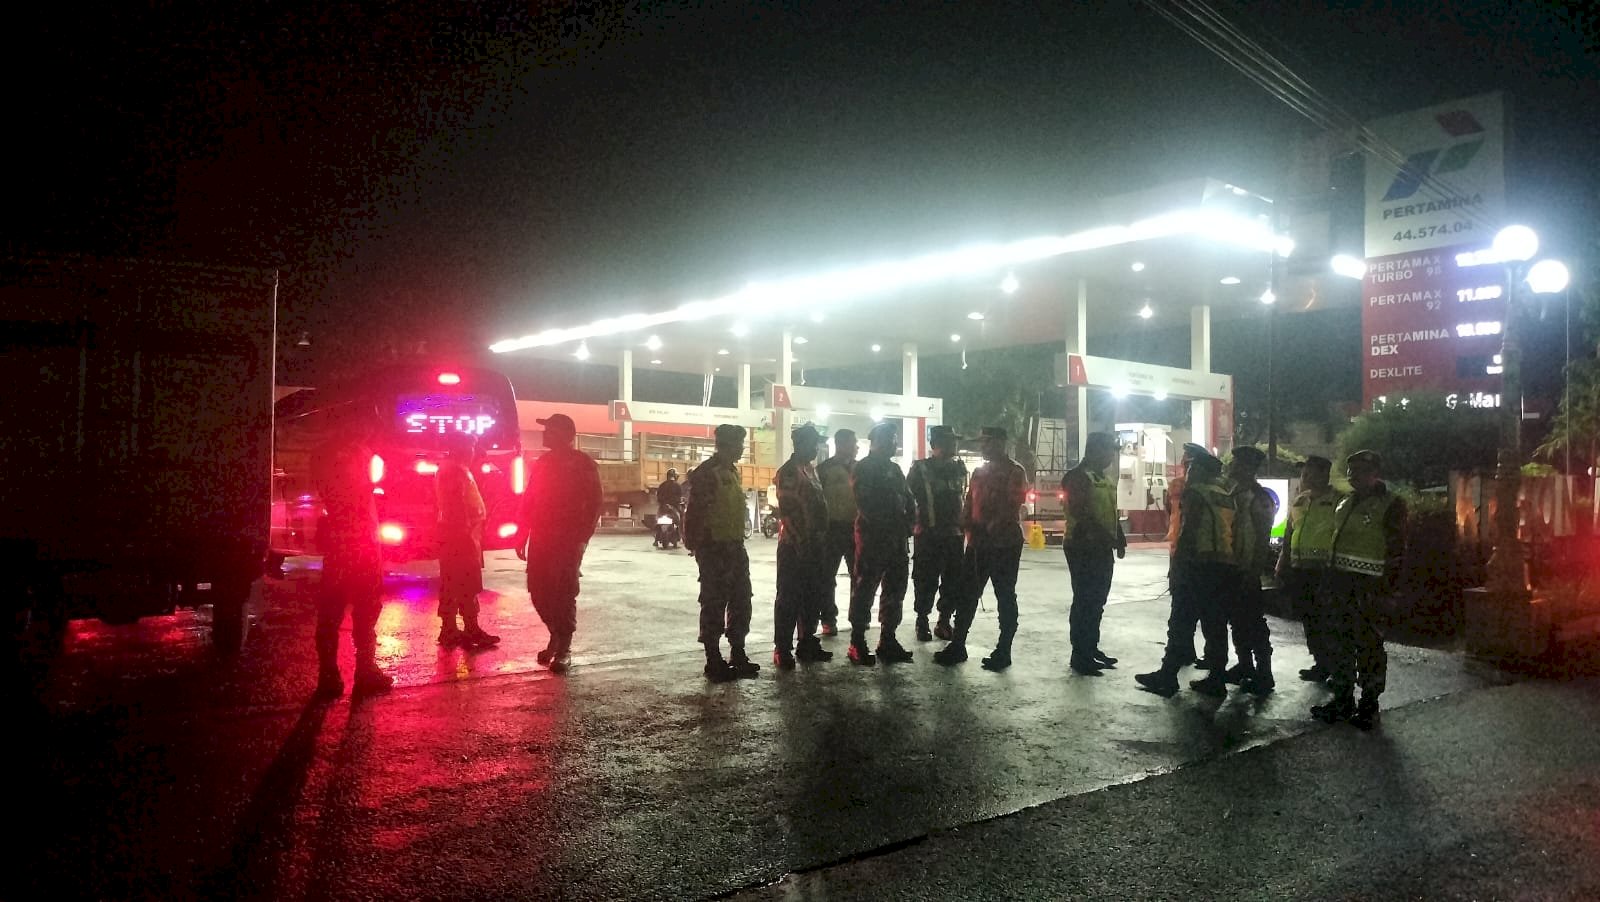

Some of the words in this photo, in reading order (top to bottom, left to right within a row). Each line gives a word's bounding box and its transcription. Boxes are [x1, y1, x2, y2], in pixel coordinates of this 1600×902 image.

[1383, 192, 1483, 220] PERTAMINA
[1369, 255, 1441, 273] PERTAMAX
[1371, 270, 1413, 284] TURBO
[1370, 289, 1442, 307] PERTAMAX
[1426, 300, 1442, 311] 92
[1371, 328, 1450, 345] PERTAMINA
[1371, 345, 1399, 356] DEX
[1370, 365, 1423, 379] DEXLITE
[406, 414, 496, 434] STOP
